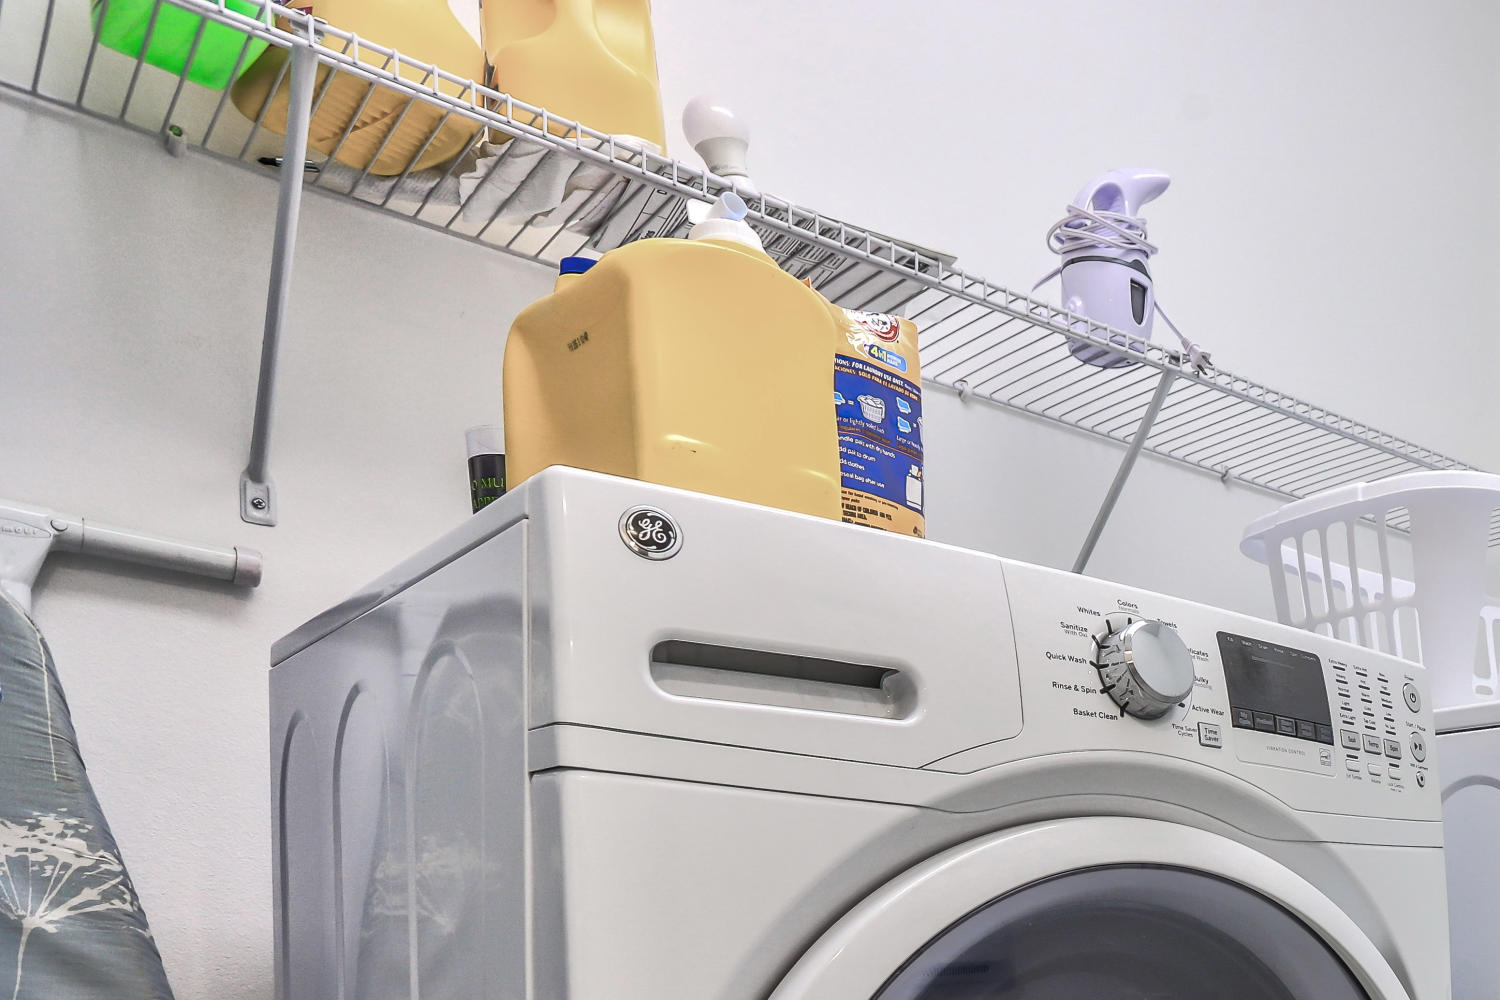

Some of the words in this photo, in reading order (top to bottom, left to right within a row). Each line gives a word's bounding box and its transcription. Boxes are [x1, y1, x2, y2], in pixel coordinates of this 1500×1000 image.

[834, 357, 851, 367] TIONS:
[851, 361, 863, 370] FOR
[863, 364, 884, 377] LAUNDRY
[1116, 599, 1138, 609] Colors
[1077, 605, 1101, 616] Whites
[1060, 621, 1088, 632] Sanitize
[1064, 628, 1078, 636] With
[1045, 651, 1067, 661] Quick
[1067, 655, 1087, 664] Wash
[1188, 647, 1209, 658] licates
[1052, 681, 1072, 691] Rinse
[1073, 684, 1080, 692] &
[1080, 685, 1097, 695] Spin
[1073, 707, 1098, 718] Basket
[1098, 711, 1119, 721] Clean
[1191, 704, 1210, 714] Active
[1210, 707, 1225, 716] Wear
[1171, 723, 1184, 731] Time
[1184, 725, 1198, 733] Saver
[1204, 727, 1218, 736] Time
[1177, 730, 1194, 738] Cycles
[1204, 734, 1219, 743] Saver
[1367, 740, 1380, 749] Temp
[1389, 744, 1399, 753] Spin
